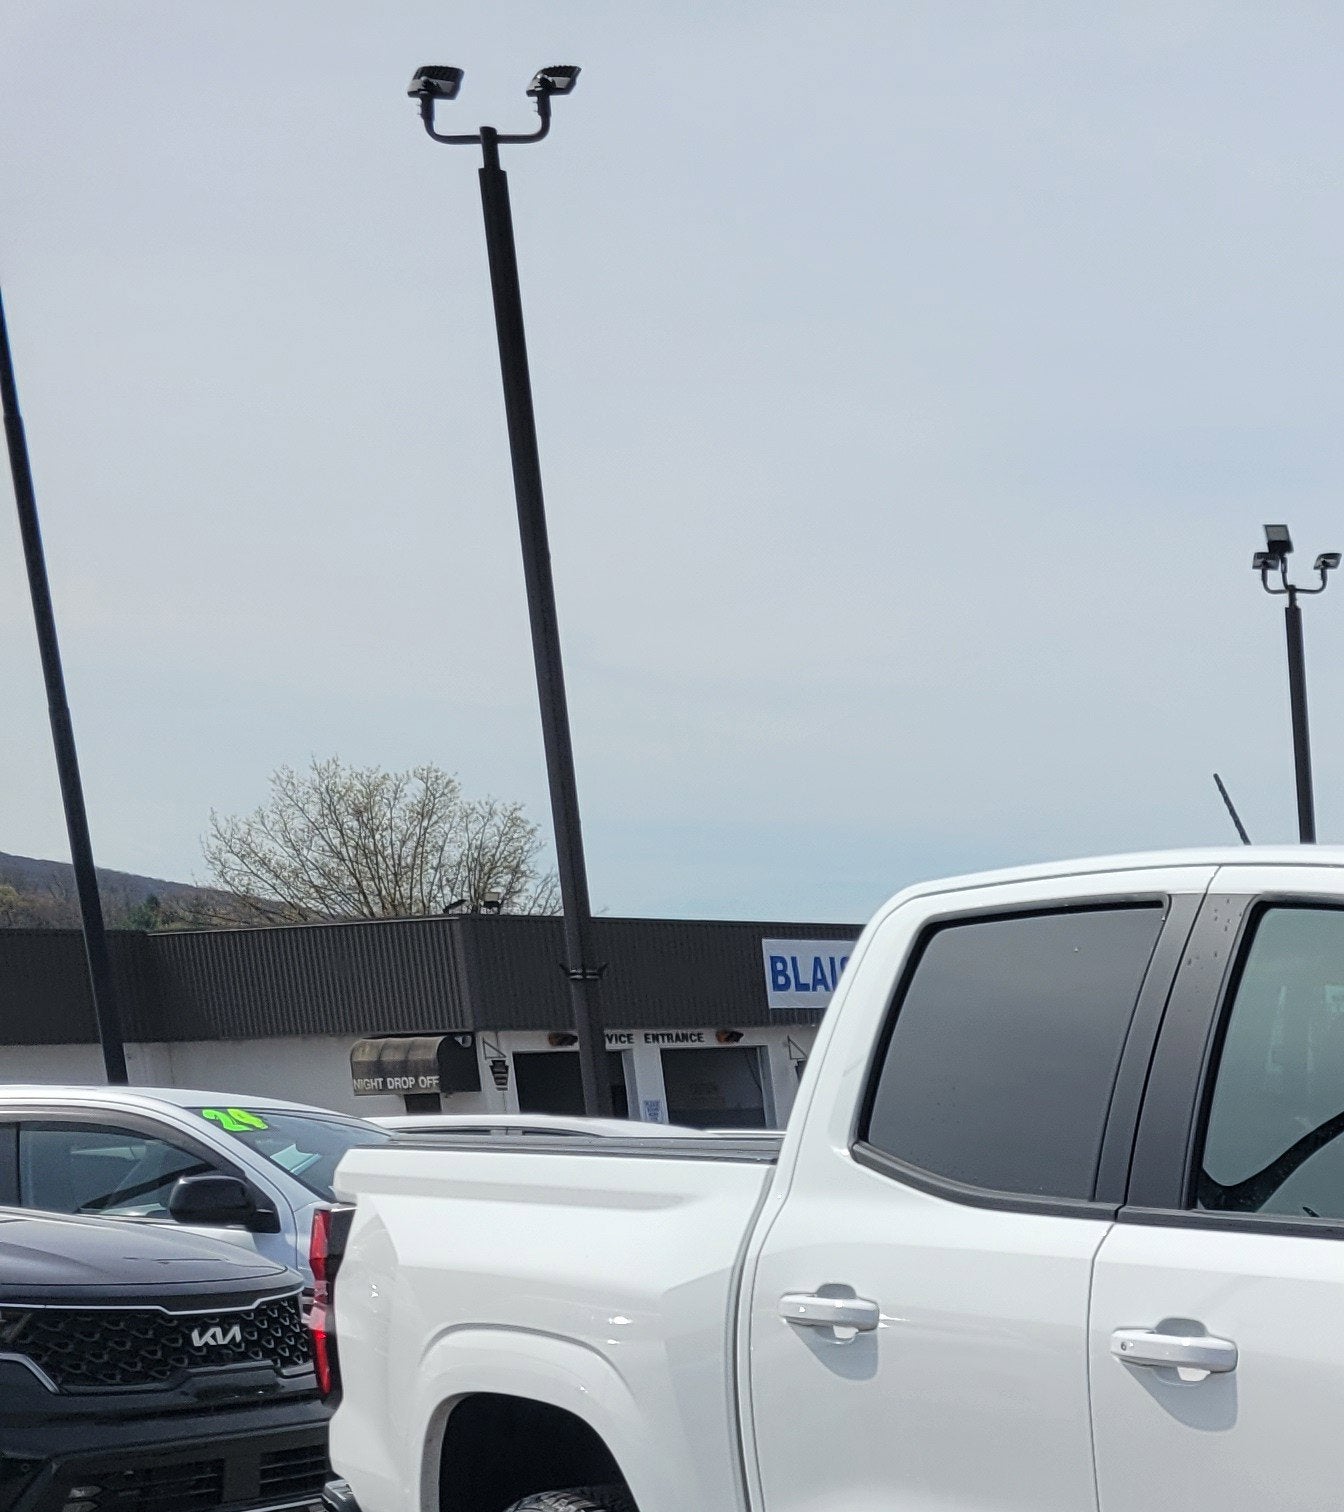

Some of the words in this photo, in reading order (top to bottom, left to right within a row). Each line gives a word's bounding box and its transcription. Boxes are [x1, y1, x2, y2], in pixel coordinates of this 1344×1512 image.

[769, 955, 850, 992] BLAI
[605, 1033, 634, 1044] VICE
[644, 1032, 705, 1044] ENTRANCE
[353, 1077, 384, 1090] NIGHT
[386, 1076, 416, 1090] DROP
[418, 1075, 440, 1089] OFF
